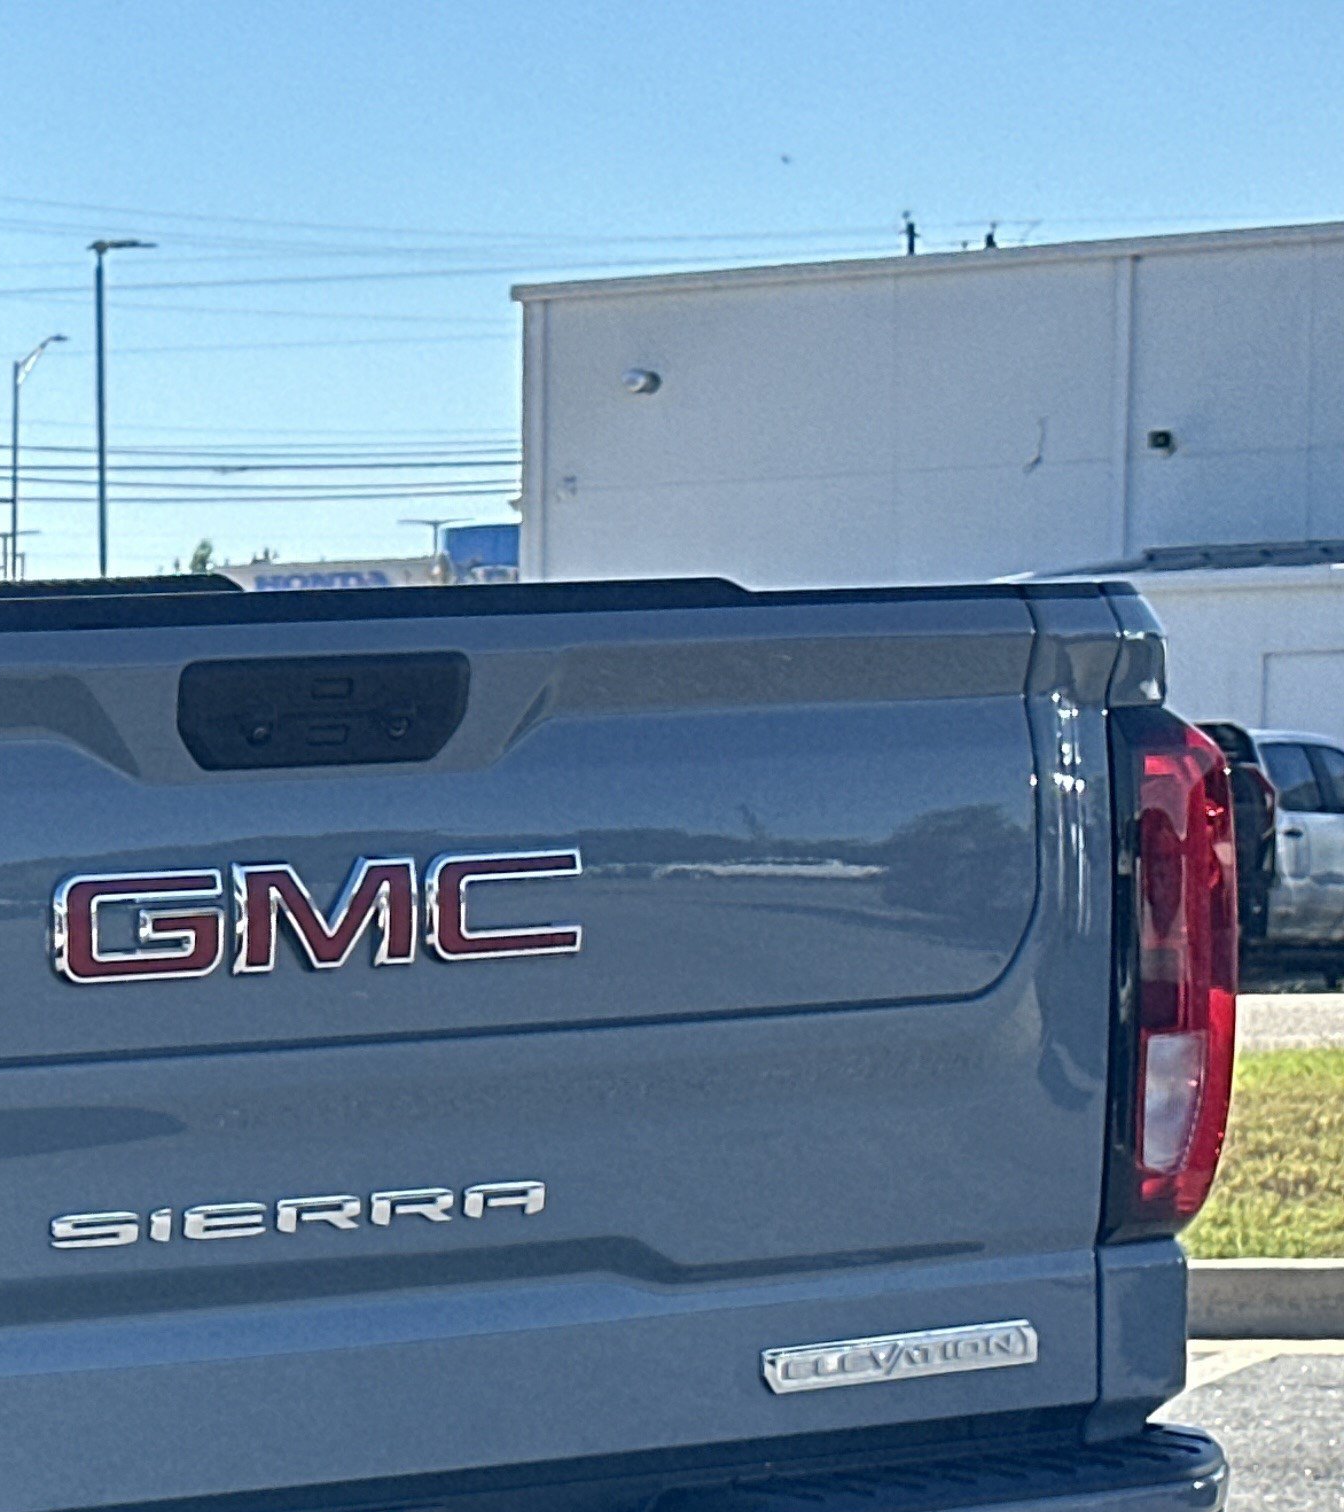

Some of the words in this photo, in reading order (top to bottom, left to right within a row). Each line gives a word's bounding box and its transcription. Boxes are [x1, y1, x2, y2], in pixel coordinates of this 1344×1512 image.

[49, 847, 584, 986] GMC
[50, 1179, 547, 1250] SIERRA
[781, 1331, 1020, 1380] ELEVATION
